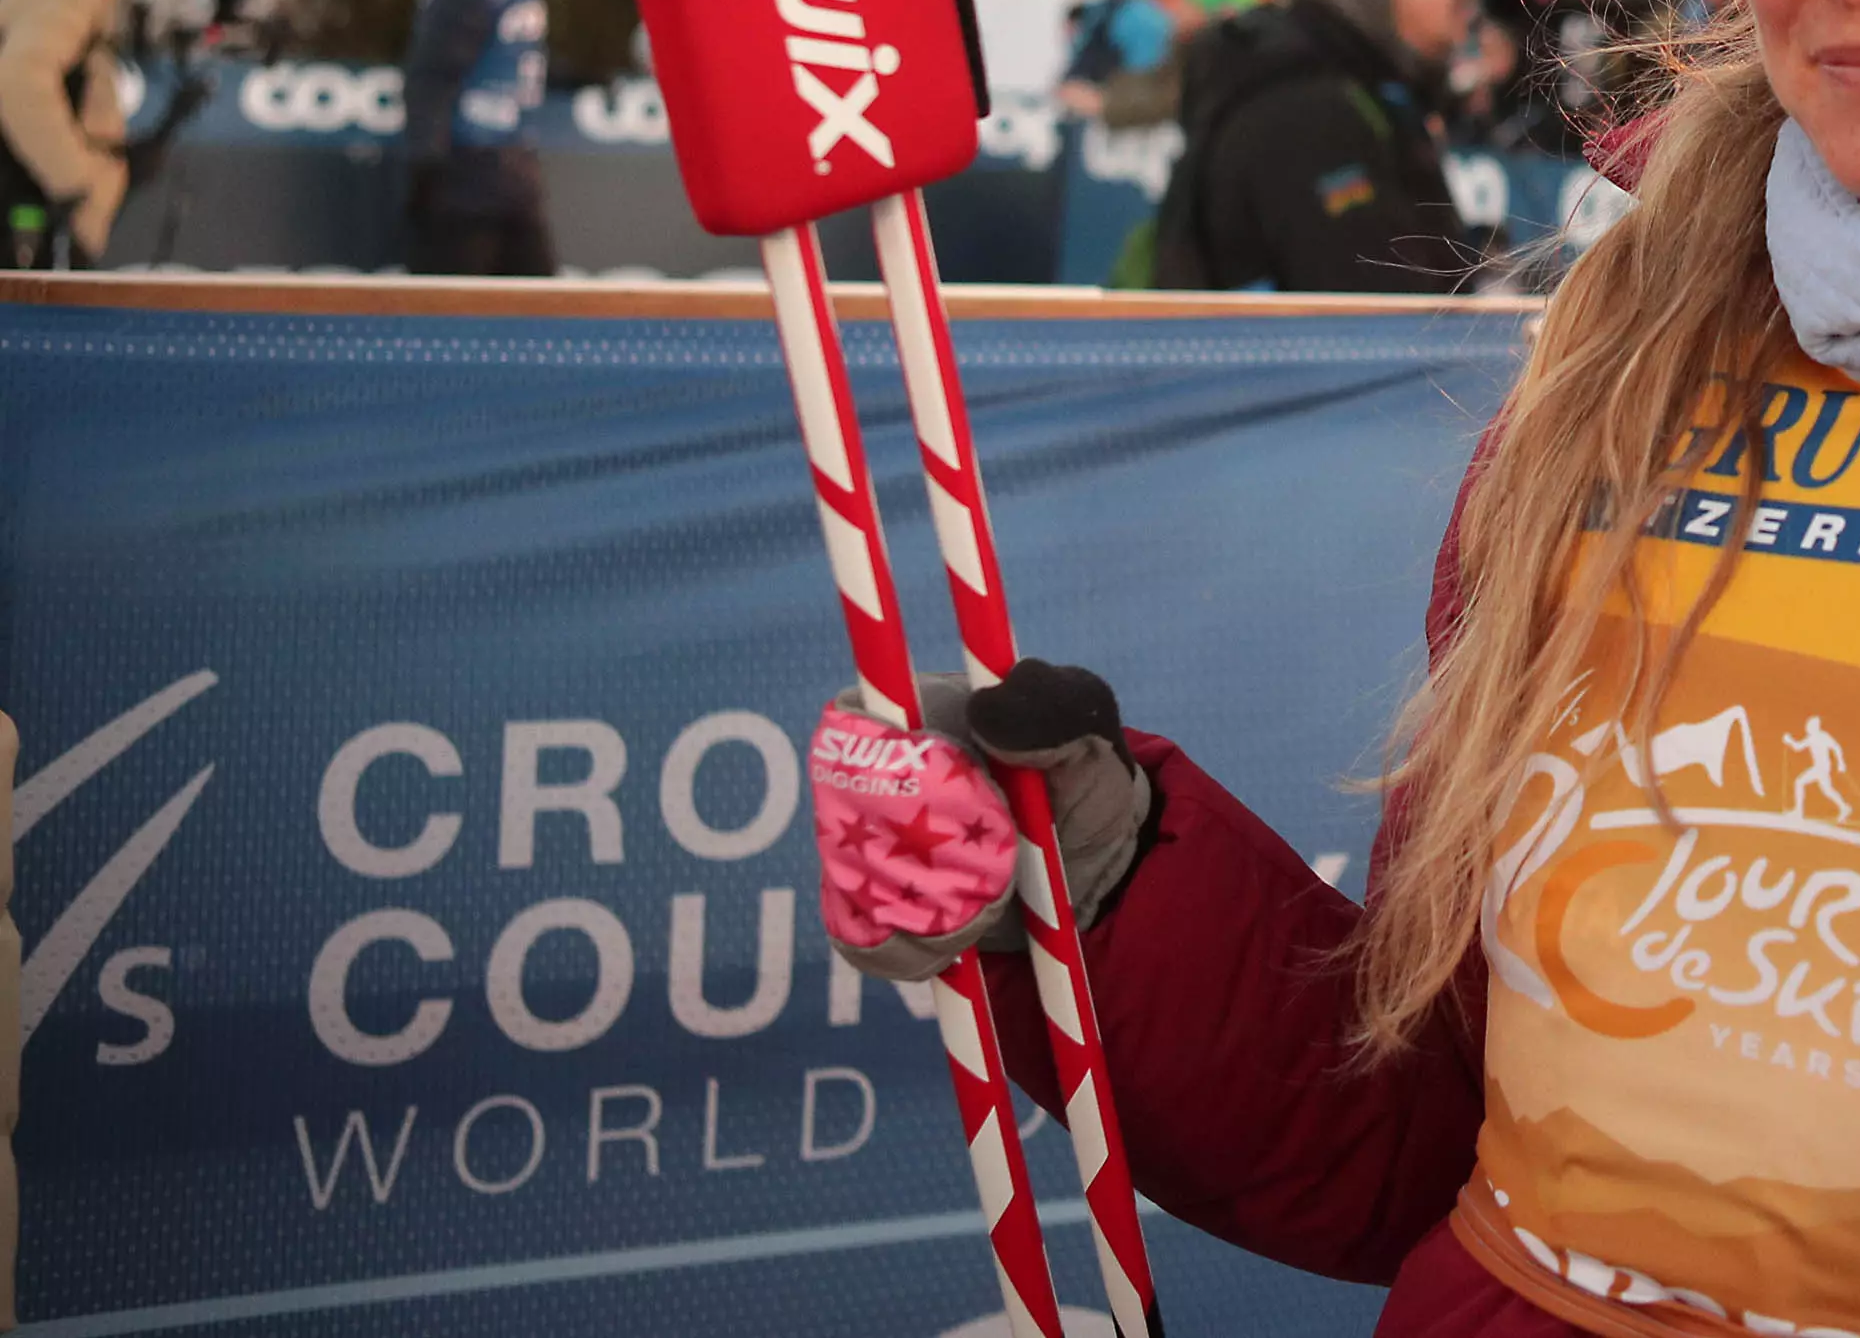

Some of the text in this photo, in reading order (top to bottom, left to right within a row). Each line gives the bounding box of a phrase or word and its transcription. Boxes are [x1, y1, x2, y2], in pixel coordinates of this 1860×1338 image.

[238, 62, 407, 137] coo
[811, 764, 921, 798] DIGGINS
[812, 727, 936, 772] SWIX
[316, 708, 802, 879] CRO
[292, 1066, 878, 1210] WORLD
